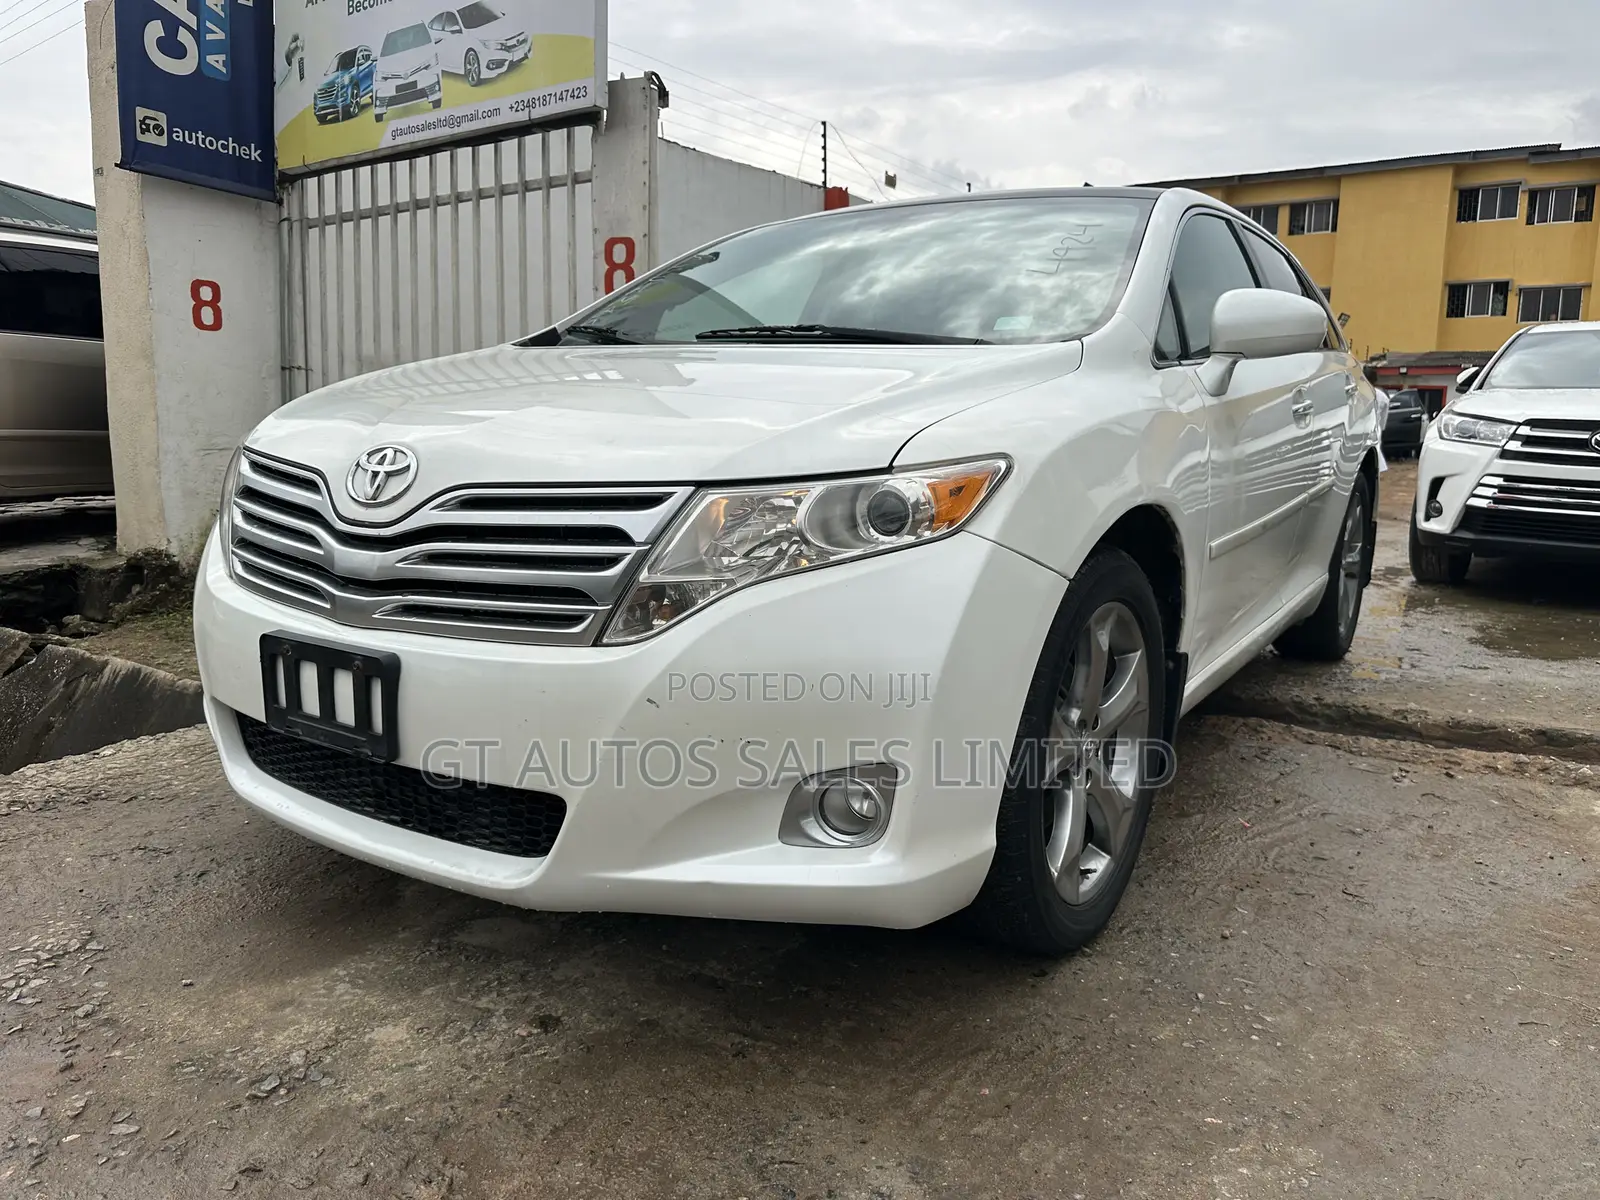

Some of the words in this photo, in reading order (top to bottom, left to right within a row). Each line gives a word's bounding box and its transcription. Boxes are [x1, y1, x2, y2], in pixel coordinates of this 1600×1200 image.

[391, 106, 501, 141] gtautosalesltd@gmail.com
[508, 85, 588, 113] +2348187147423
[172, 126, 263, 162] autochek
[604, 236, 635, 296] 8
[190, 278, 223, 332] 8
